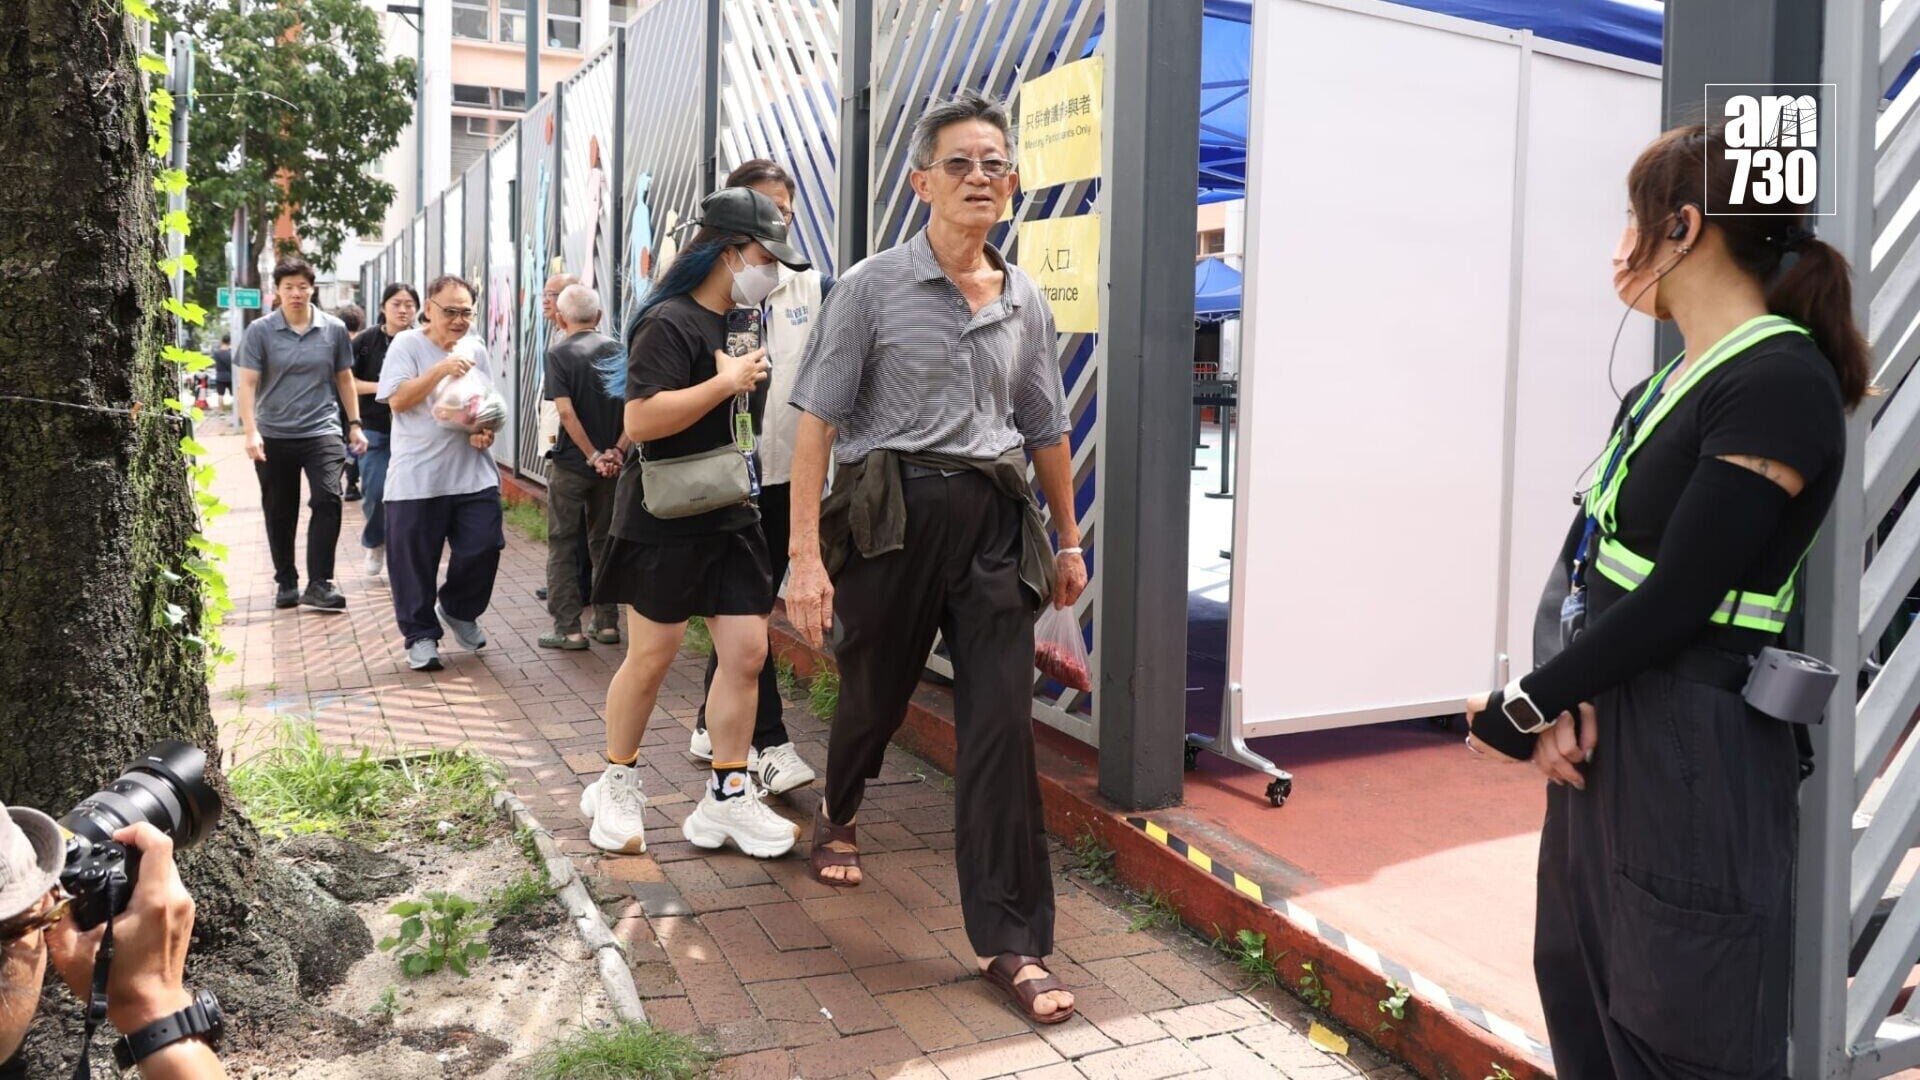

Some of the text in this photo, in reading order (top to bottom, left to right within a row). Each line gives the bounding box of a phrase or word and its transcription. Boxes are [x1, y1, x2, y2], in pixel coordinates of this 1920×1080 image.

[1045, 129, 1075, 144] Particiants
[1075, 124, 1091, 136] Only
[1040, 248, 1070, 273] 入口
[1040, 284, 1079, 302] trance
